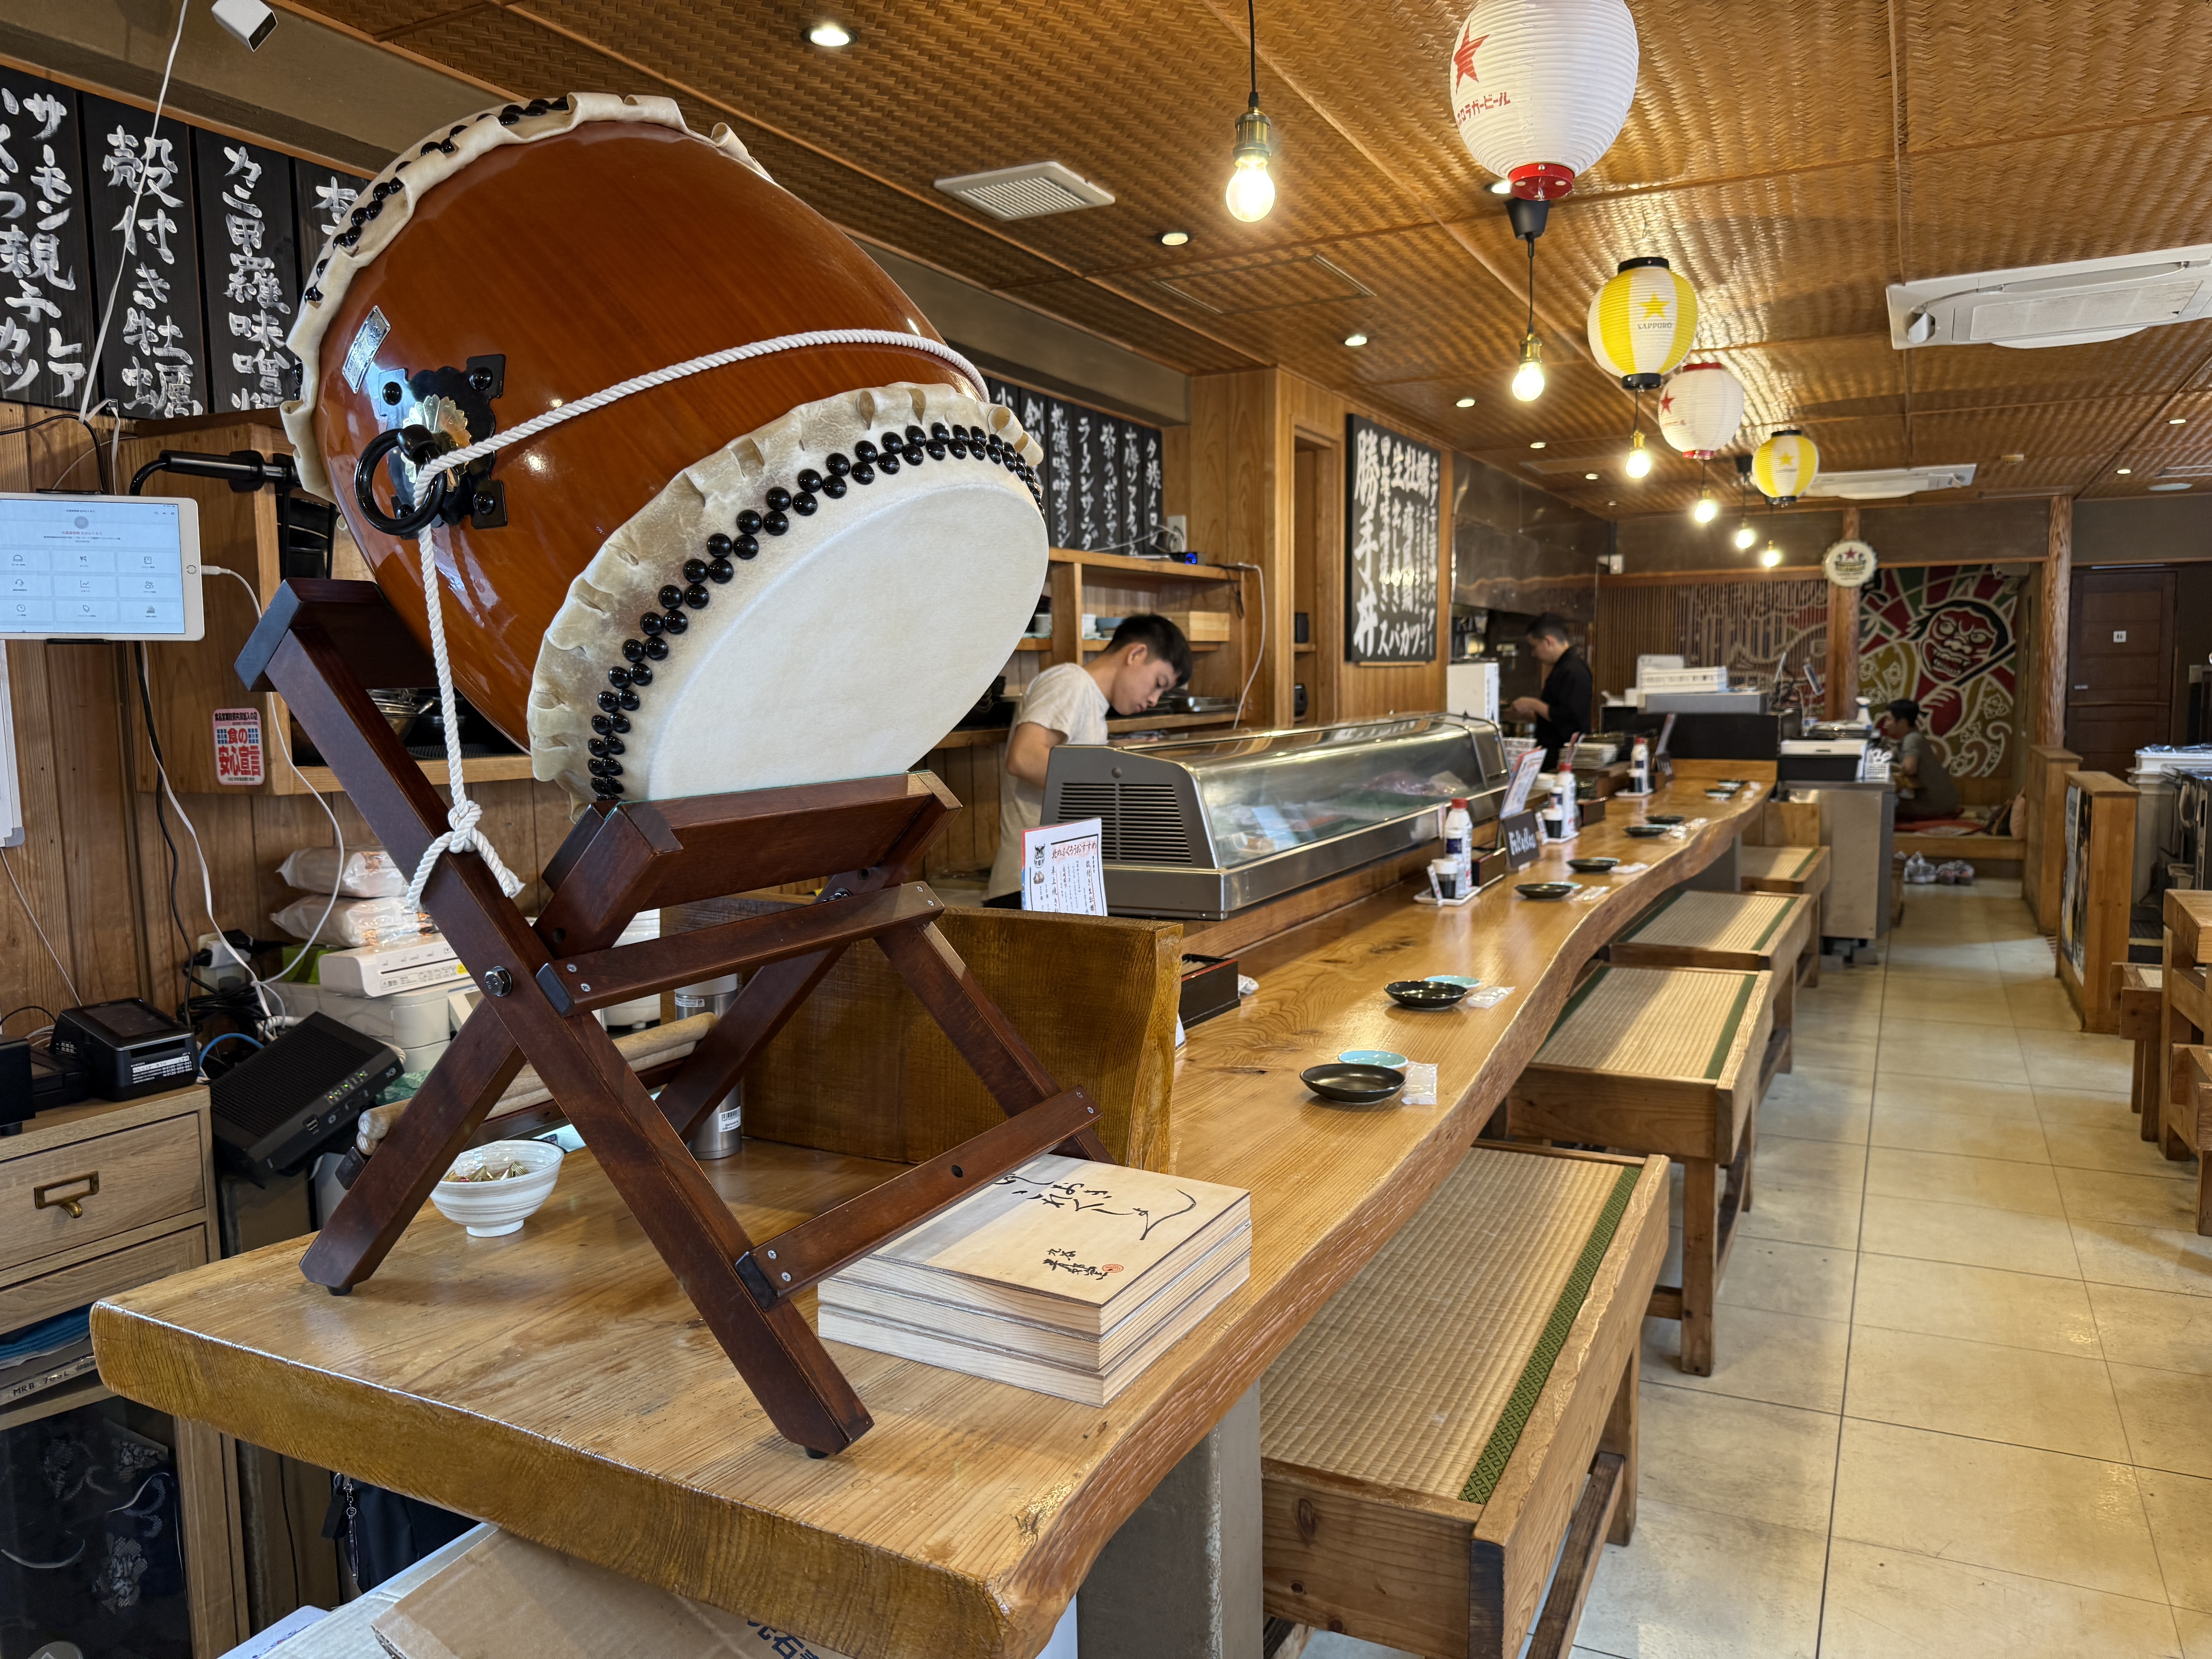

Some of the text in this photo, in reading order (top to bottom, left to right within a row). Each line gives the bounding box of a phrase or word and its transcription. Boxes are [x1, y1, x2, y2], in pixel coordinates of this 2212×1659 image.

[102, 124, 203, 419] 殻付き牡蠣
[1637, 322, 1672, 330] SAPPORO
[228, 728, 248, 744] 食の
[218, 745, 261, 776] 安心宣言
[1052, 841, 1097, 859] 北のふくろうおすすめ
